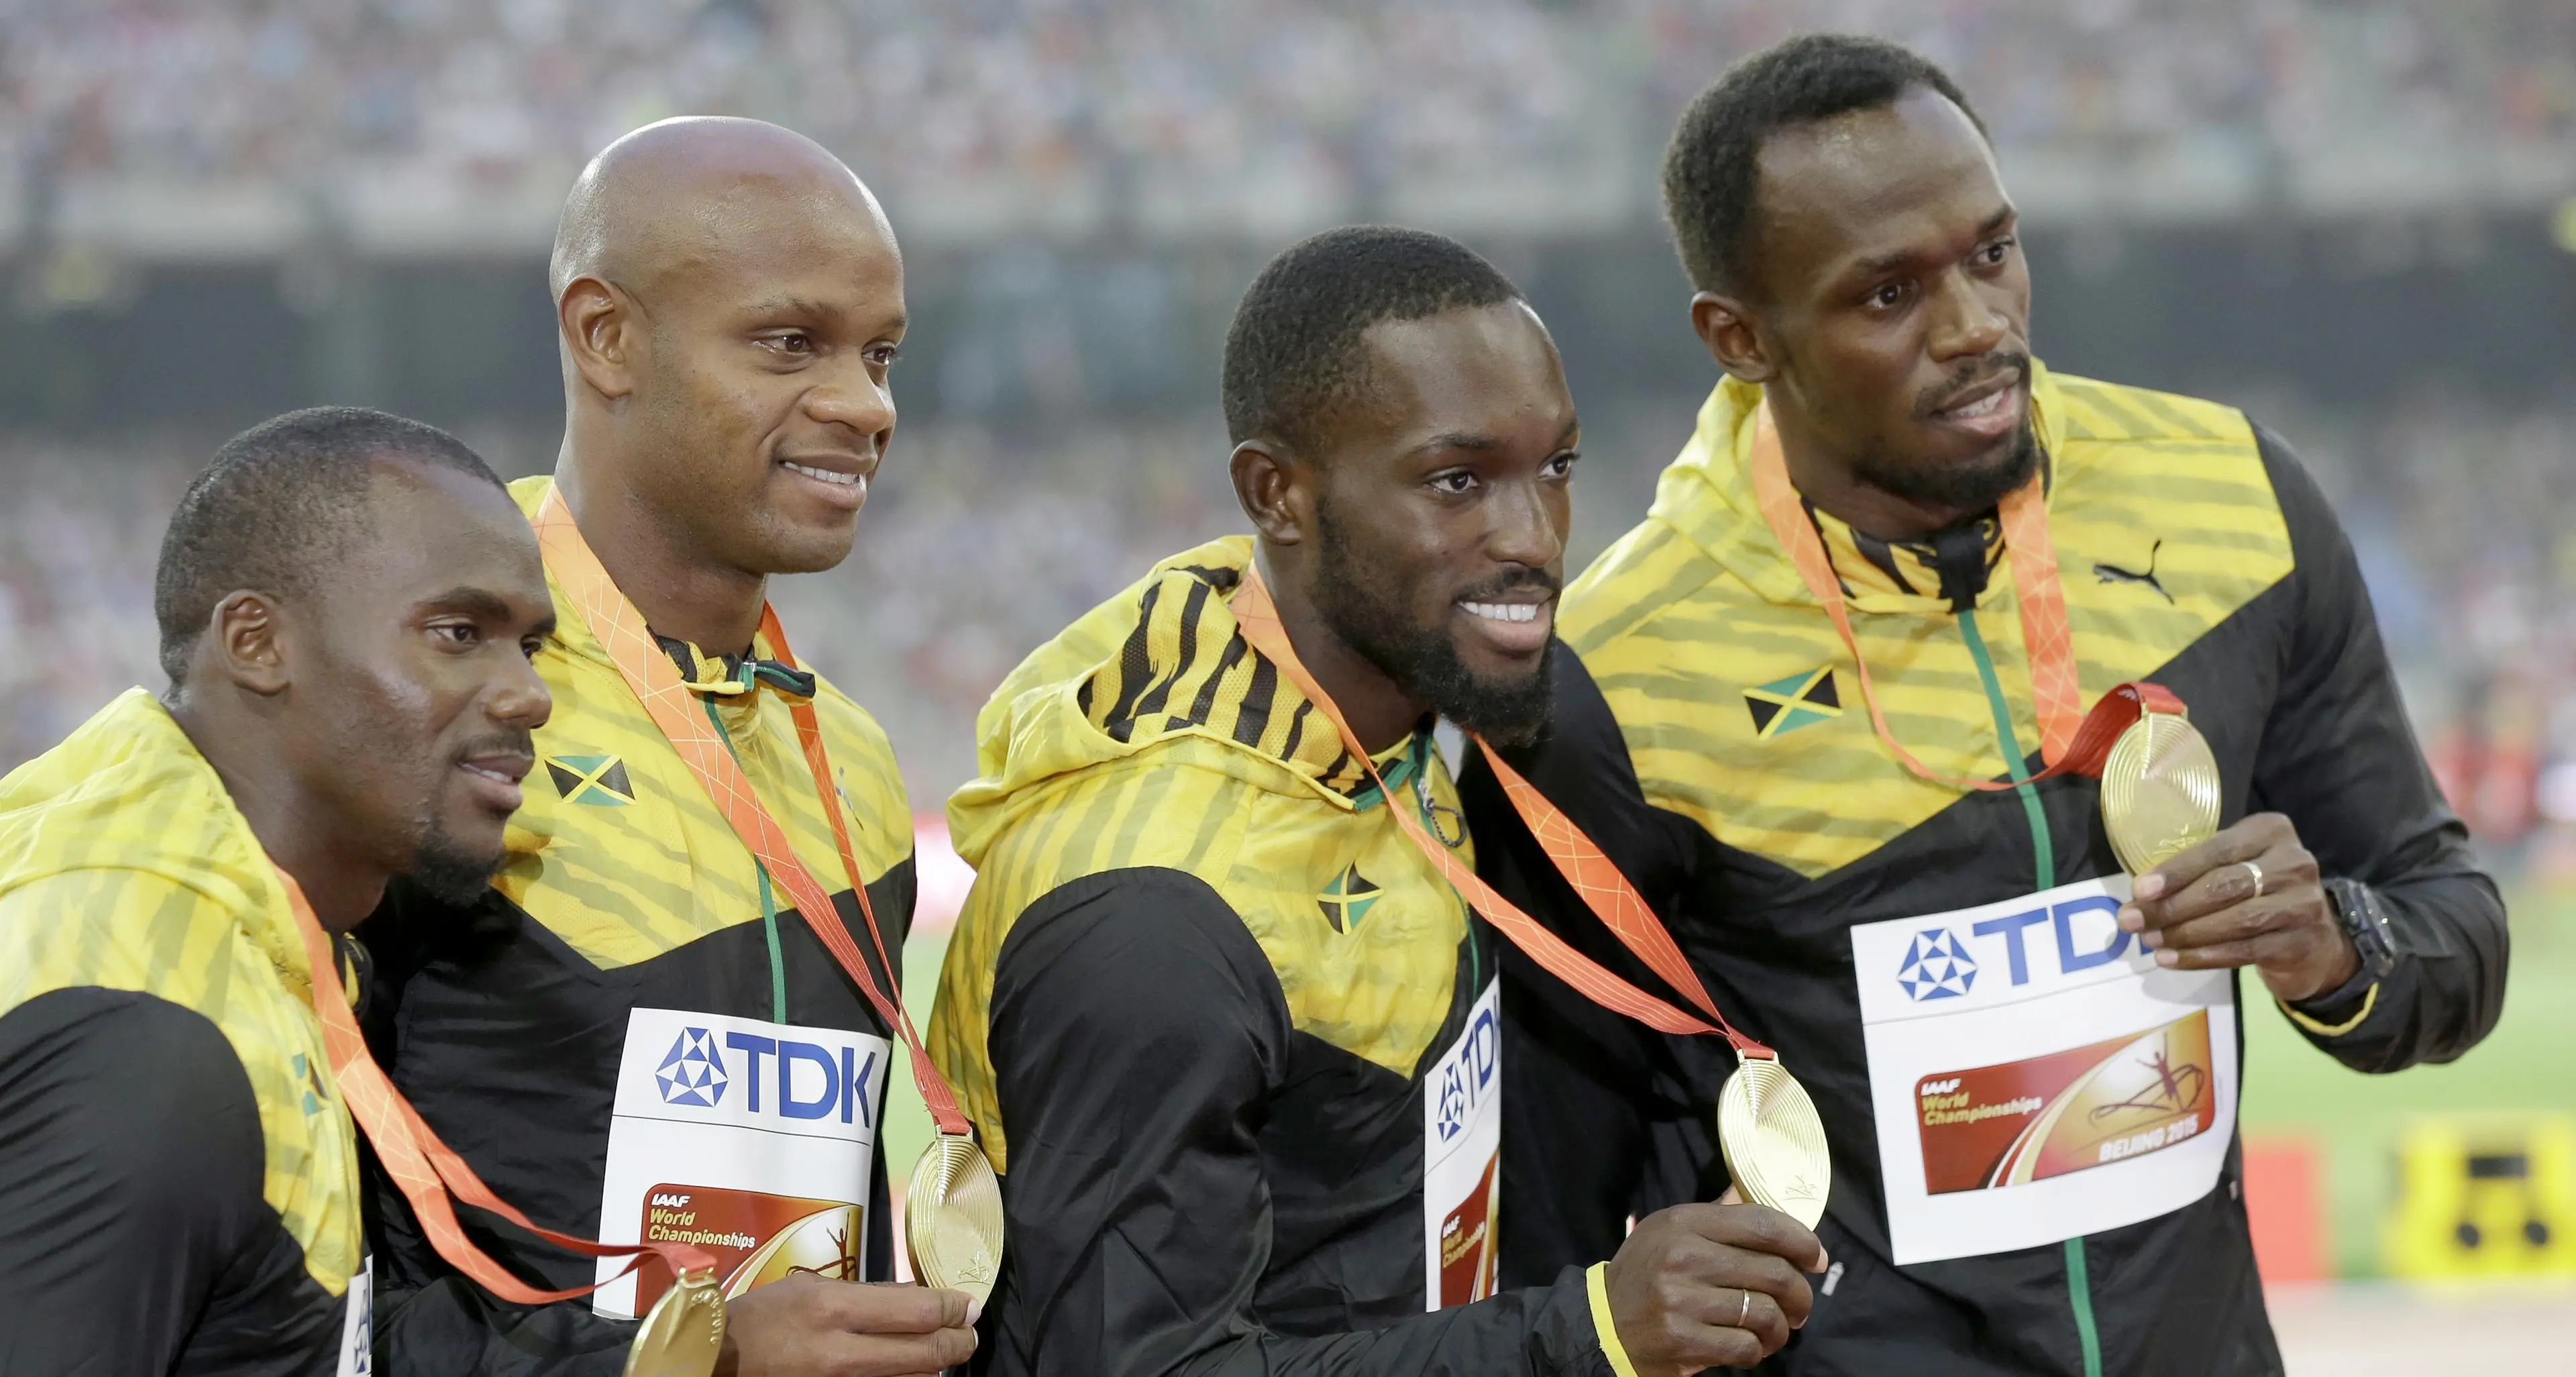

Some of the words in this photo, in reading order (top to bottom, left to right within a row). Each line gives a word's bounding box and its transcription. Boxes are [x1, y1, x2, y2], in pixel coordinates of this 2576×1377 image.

[1973, 896, 2155, 987] TD
[727, 1032, 875, 1128] TDK
[1922, 1092, 1970, 1112] World
[1923, 1096, 2043, 1126] Championships
[2166, 1113, 2199, 1144] 2015
[651, 1193, 691, 1208] IAAF
[649, 1208, 696, 1226] World
[648, 1225, 756, 1250] Championships
